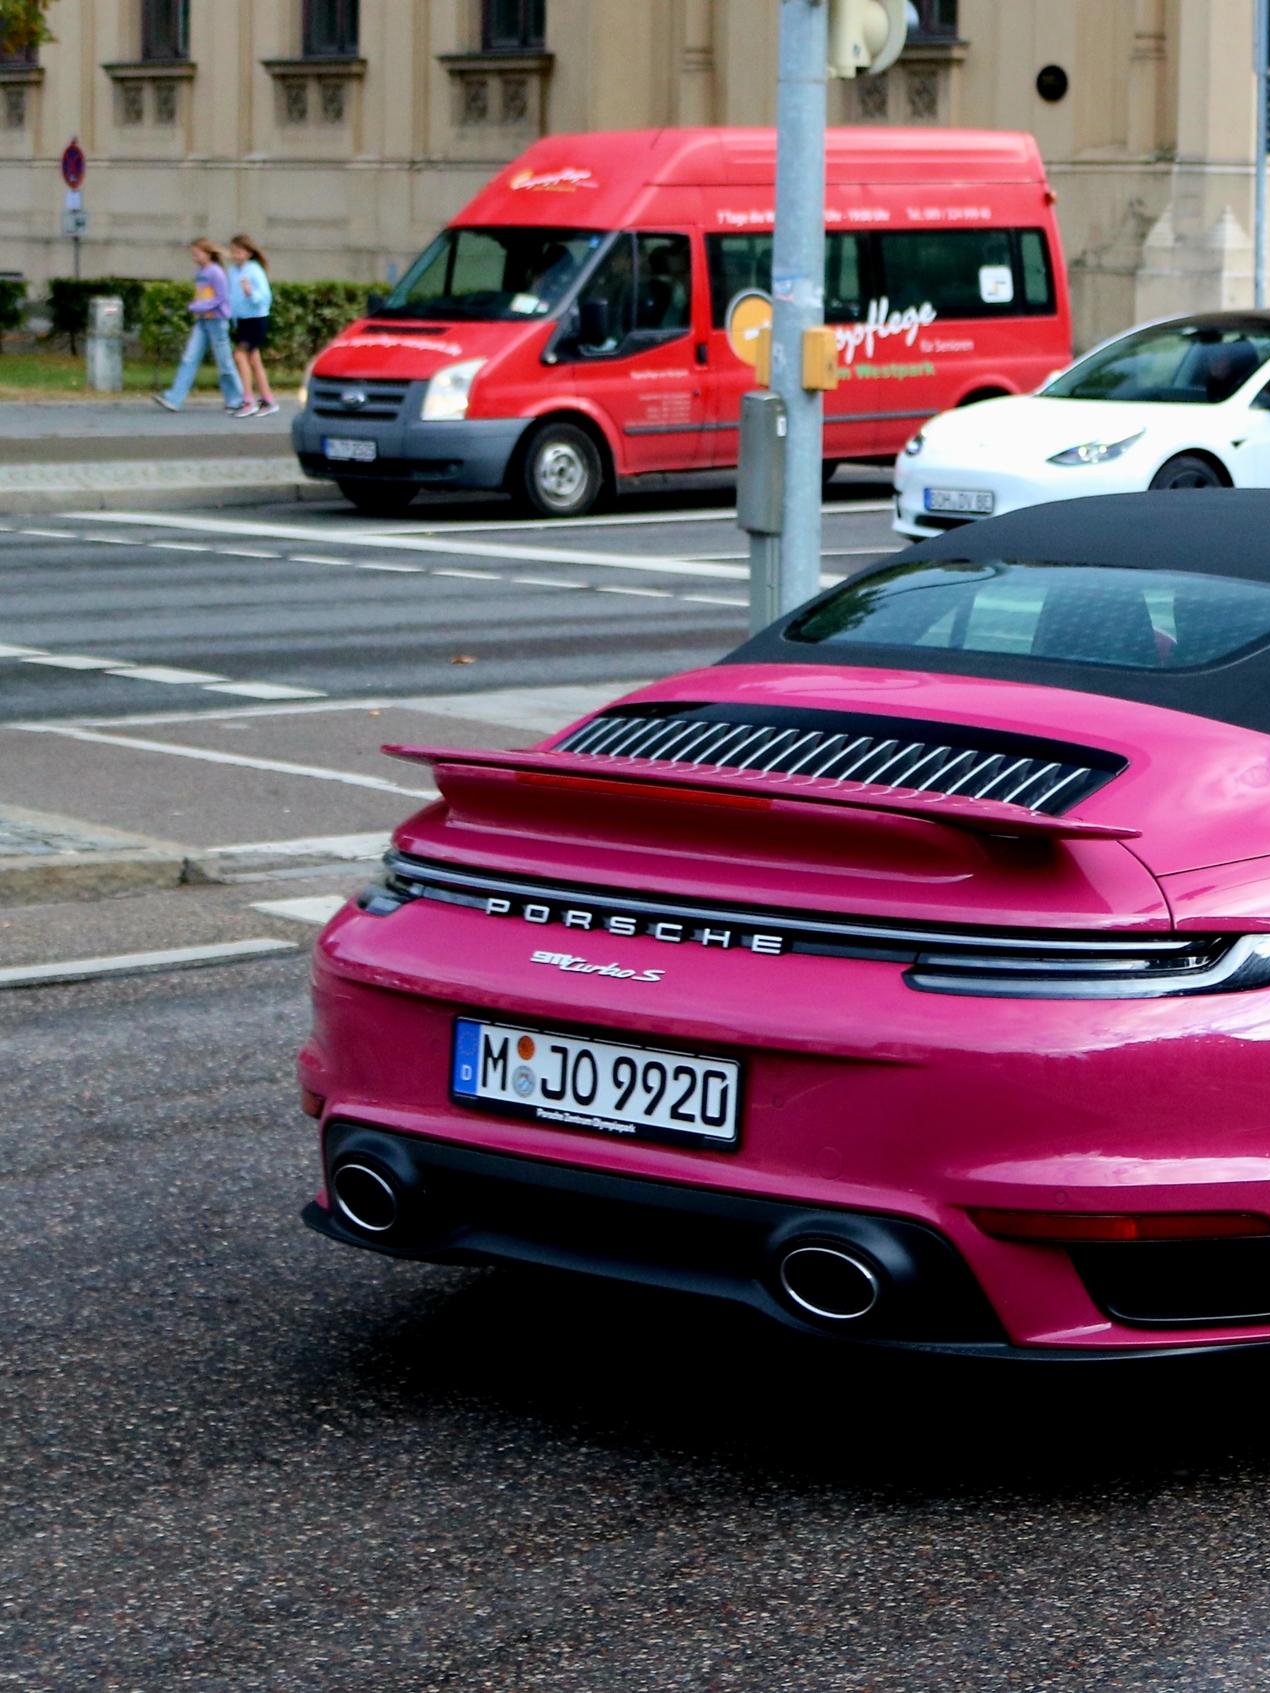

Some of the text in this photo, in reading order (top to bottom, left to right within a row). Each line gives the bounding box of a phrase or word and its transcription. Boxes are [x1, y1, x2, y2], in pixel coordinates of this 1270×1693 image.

[856, 361, 936, 380] Westpark
[485, 897, 783, 955] PORSCHE
[460, 1065, 472, 1081] D
[482, 1034, 729, 1128] M JO 9920
